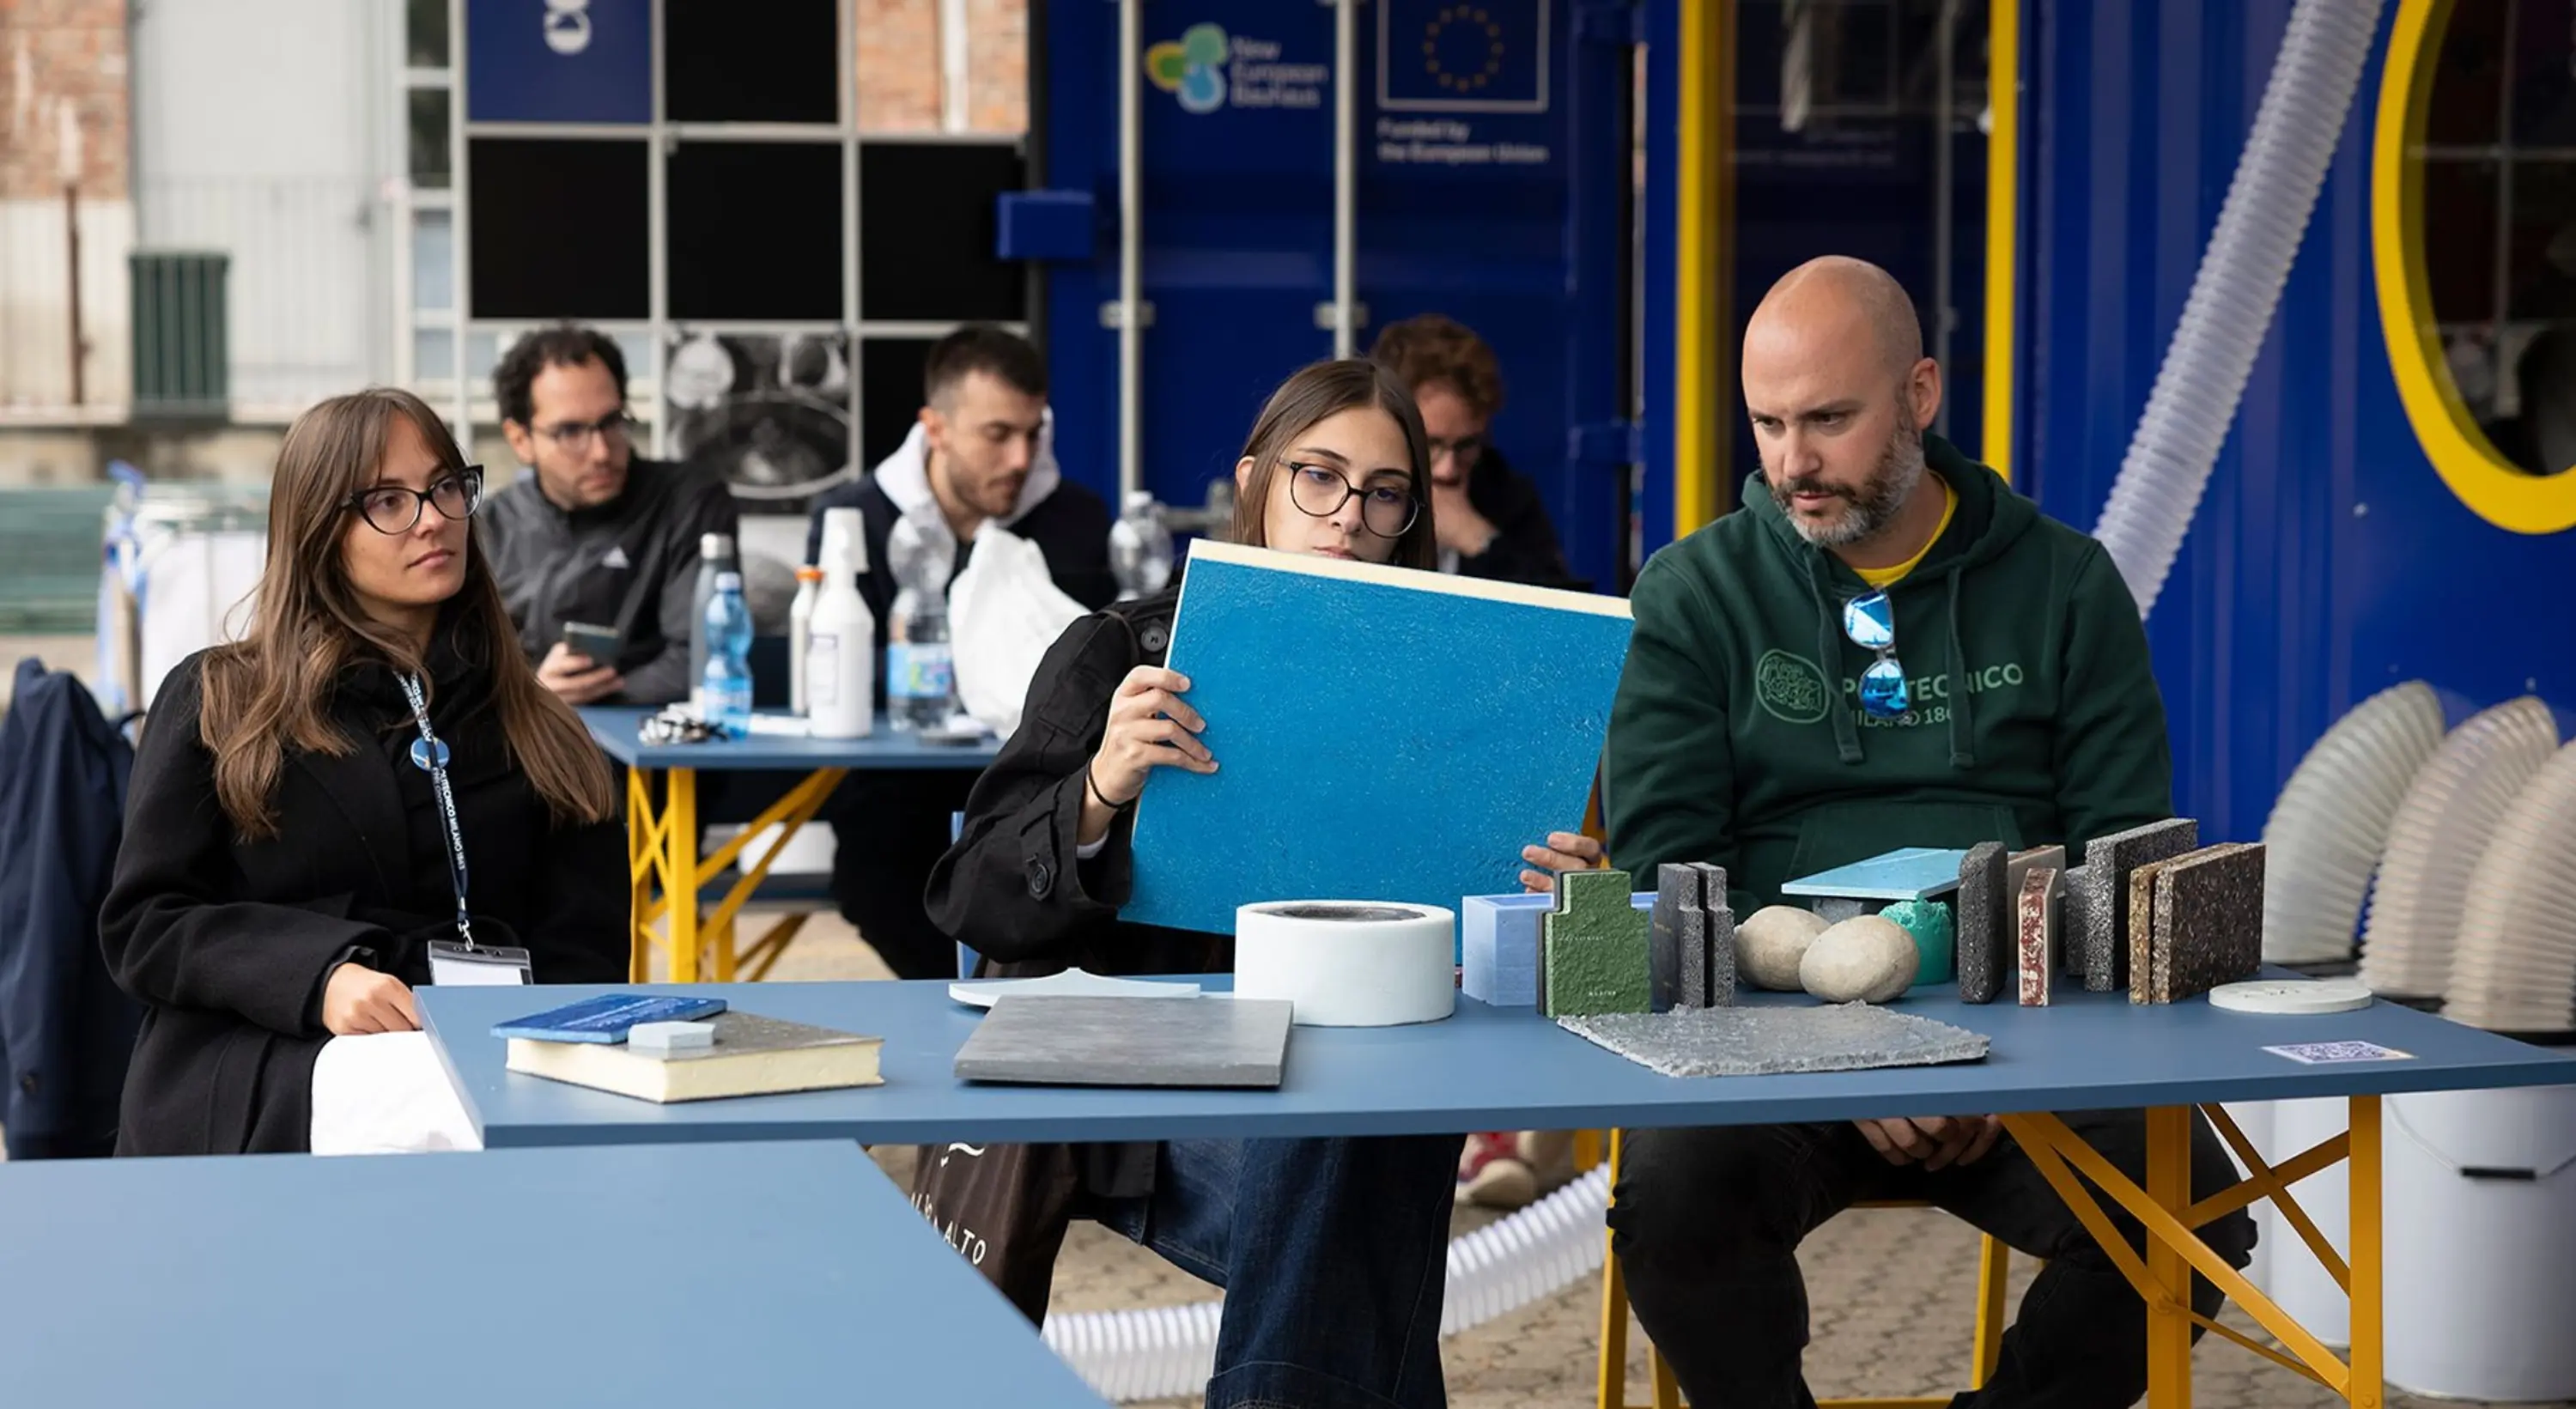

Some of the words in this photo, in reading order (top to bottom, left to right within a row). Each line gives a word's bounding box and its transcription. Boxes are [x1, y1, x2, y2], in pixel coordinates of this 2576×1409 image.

[1232, 37, 1281, 59] New
[1232, 64, 1328, 88] European
[1232, 88, 1320, 108] Bauhaus
[1376, 118, 1441, 140] Funded
[1443, 121, 1470, 143] by
[1376, 142, 1406, 162] the
[1409, 142, 1492, 167] European
[1495, 144, 1549, 163] Union
